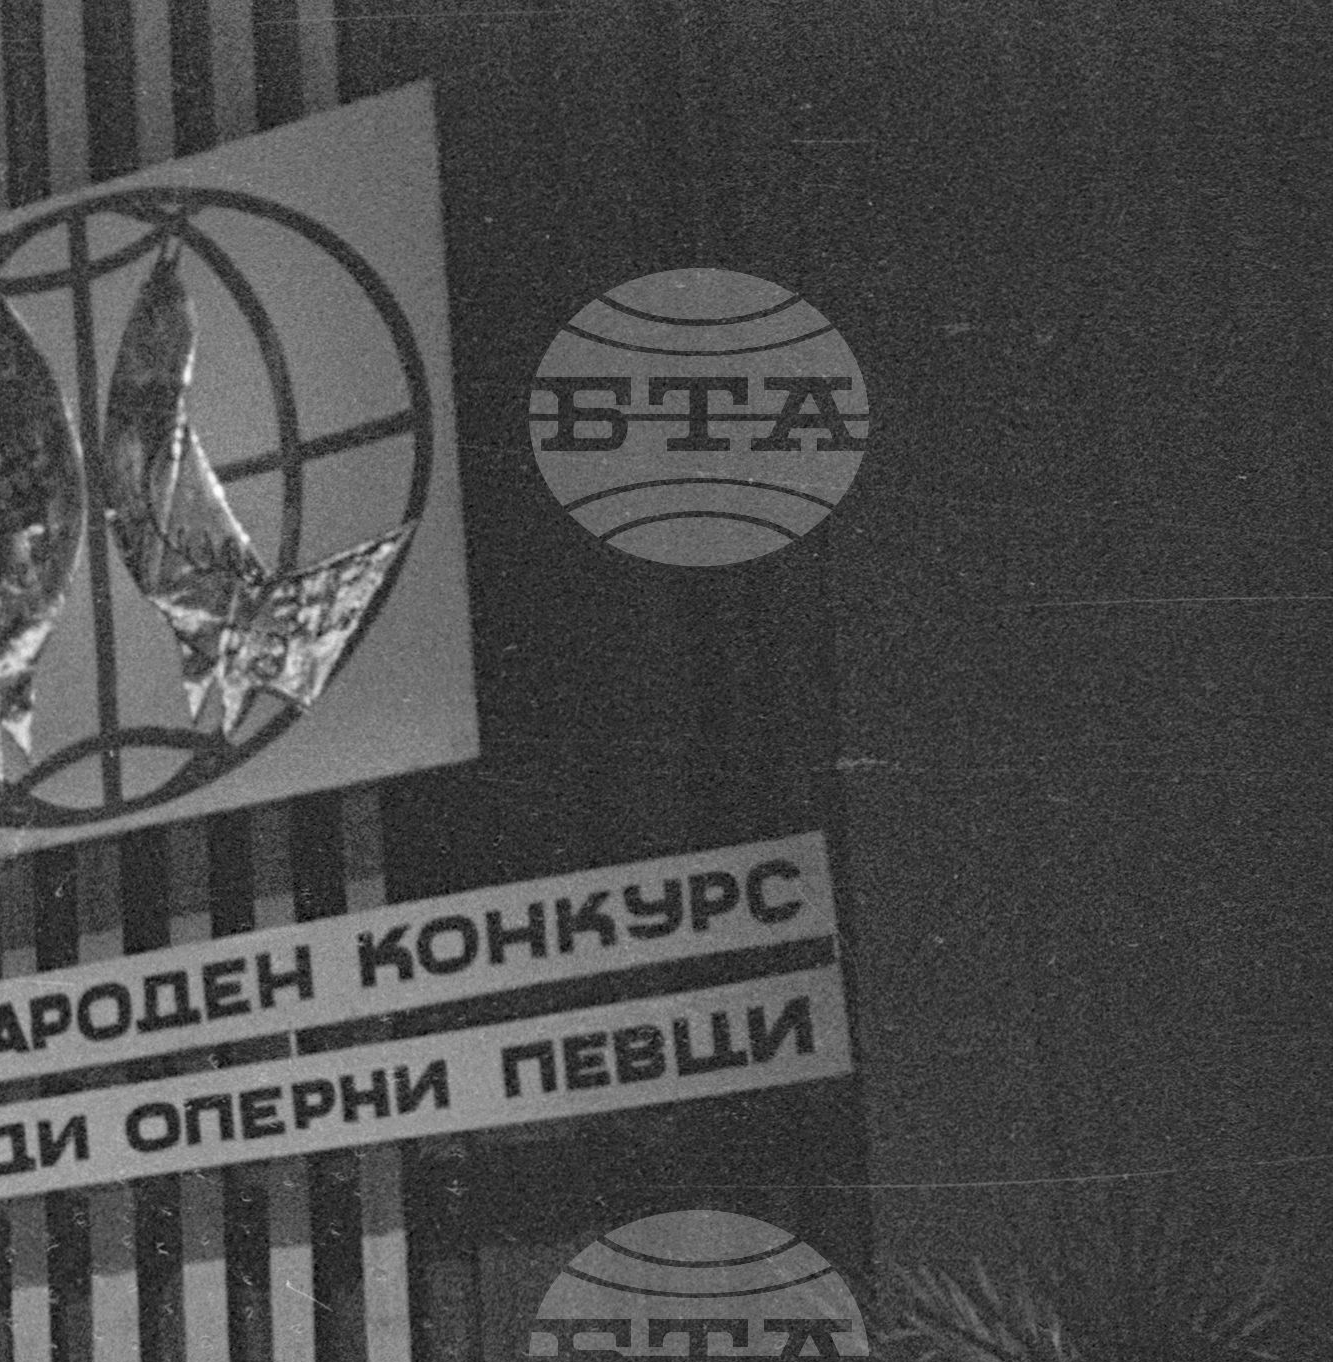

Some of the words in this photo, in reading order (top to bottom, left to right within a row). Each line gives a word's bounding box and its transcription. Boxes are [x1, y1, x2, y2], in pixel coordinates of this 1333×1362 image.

[357, 859, 802, 987] КОНКУРС
[125, 1059, 450, 1153] ОПЕРНИ
[501, 996, 816, 1098] ПЕВЦИ
